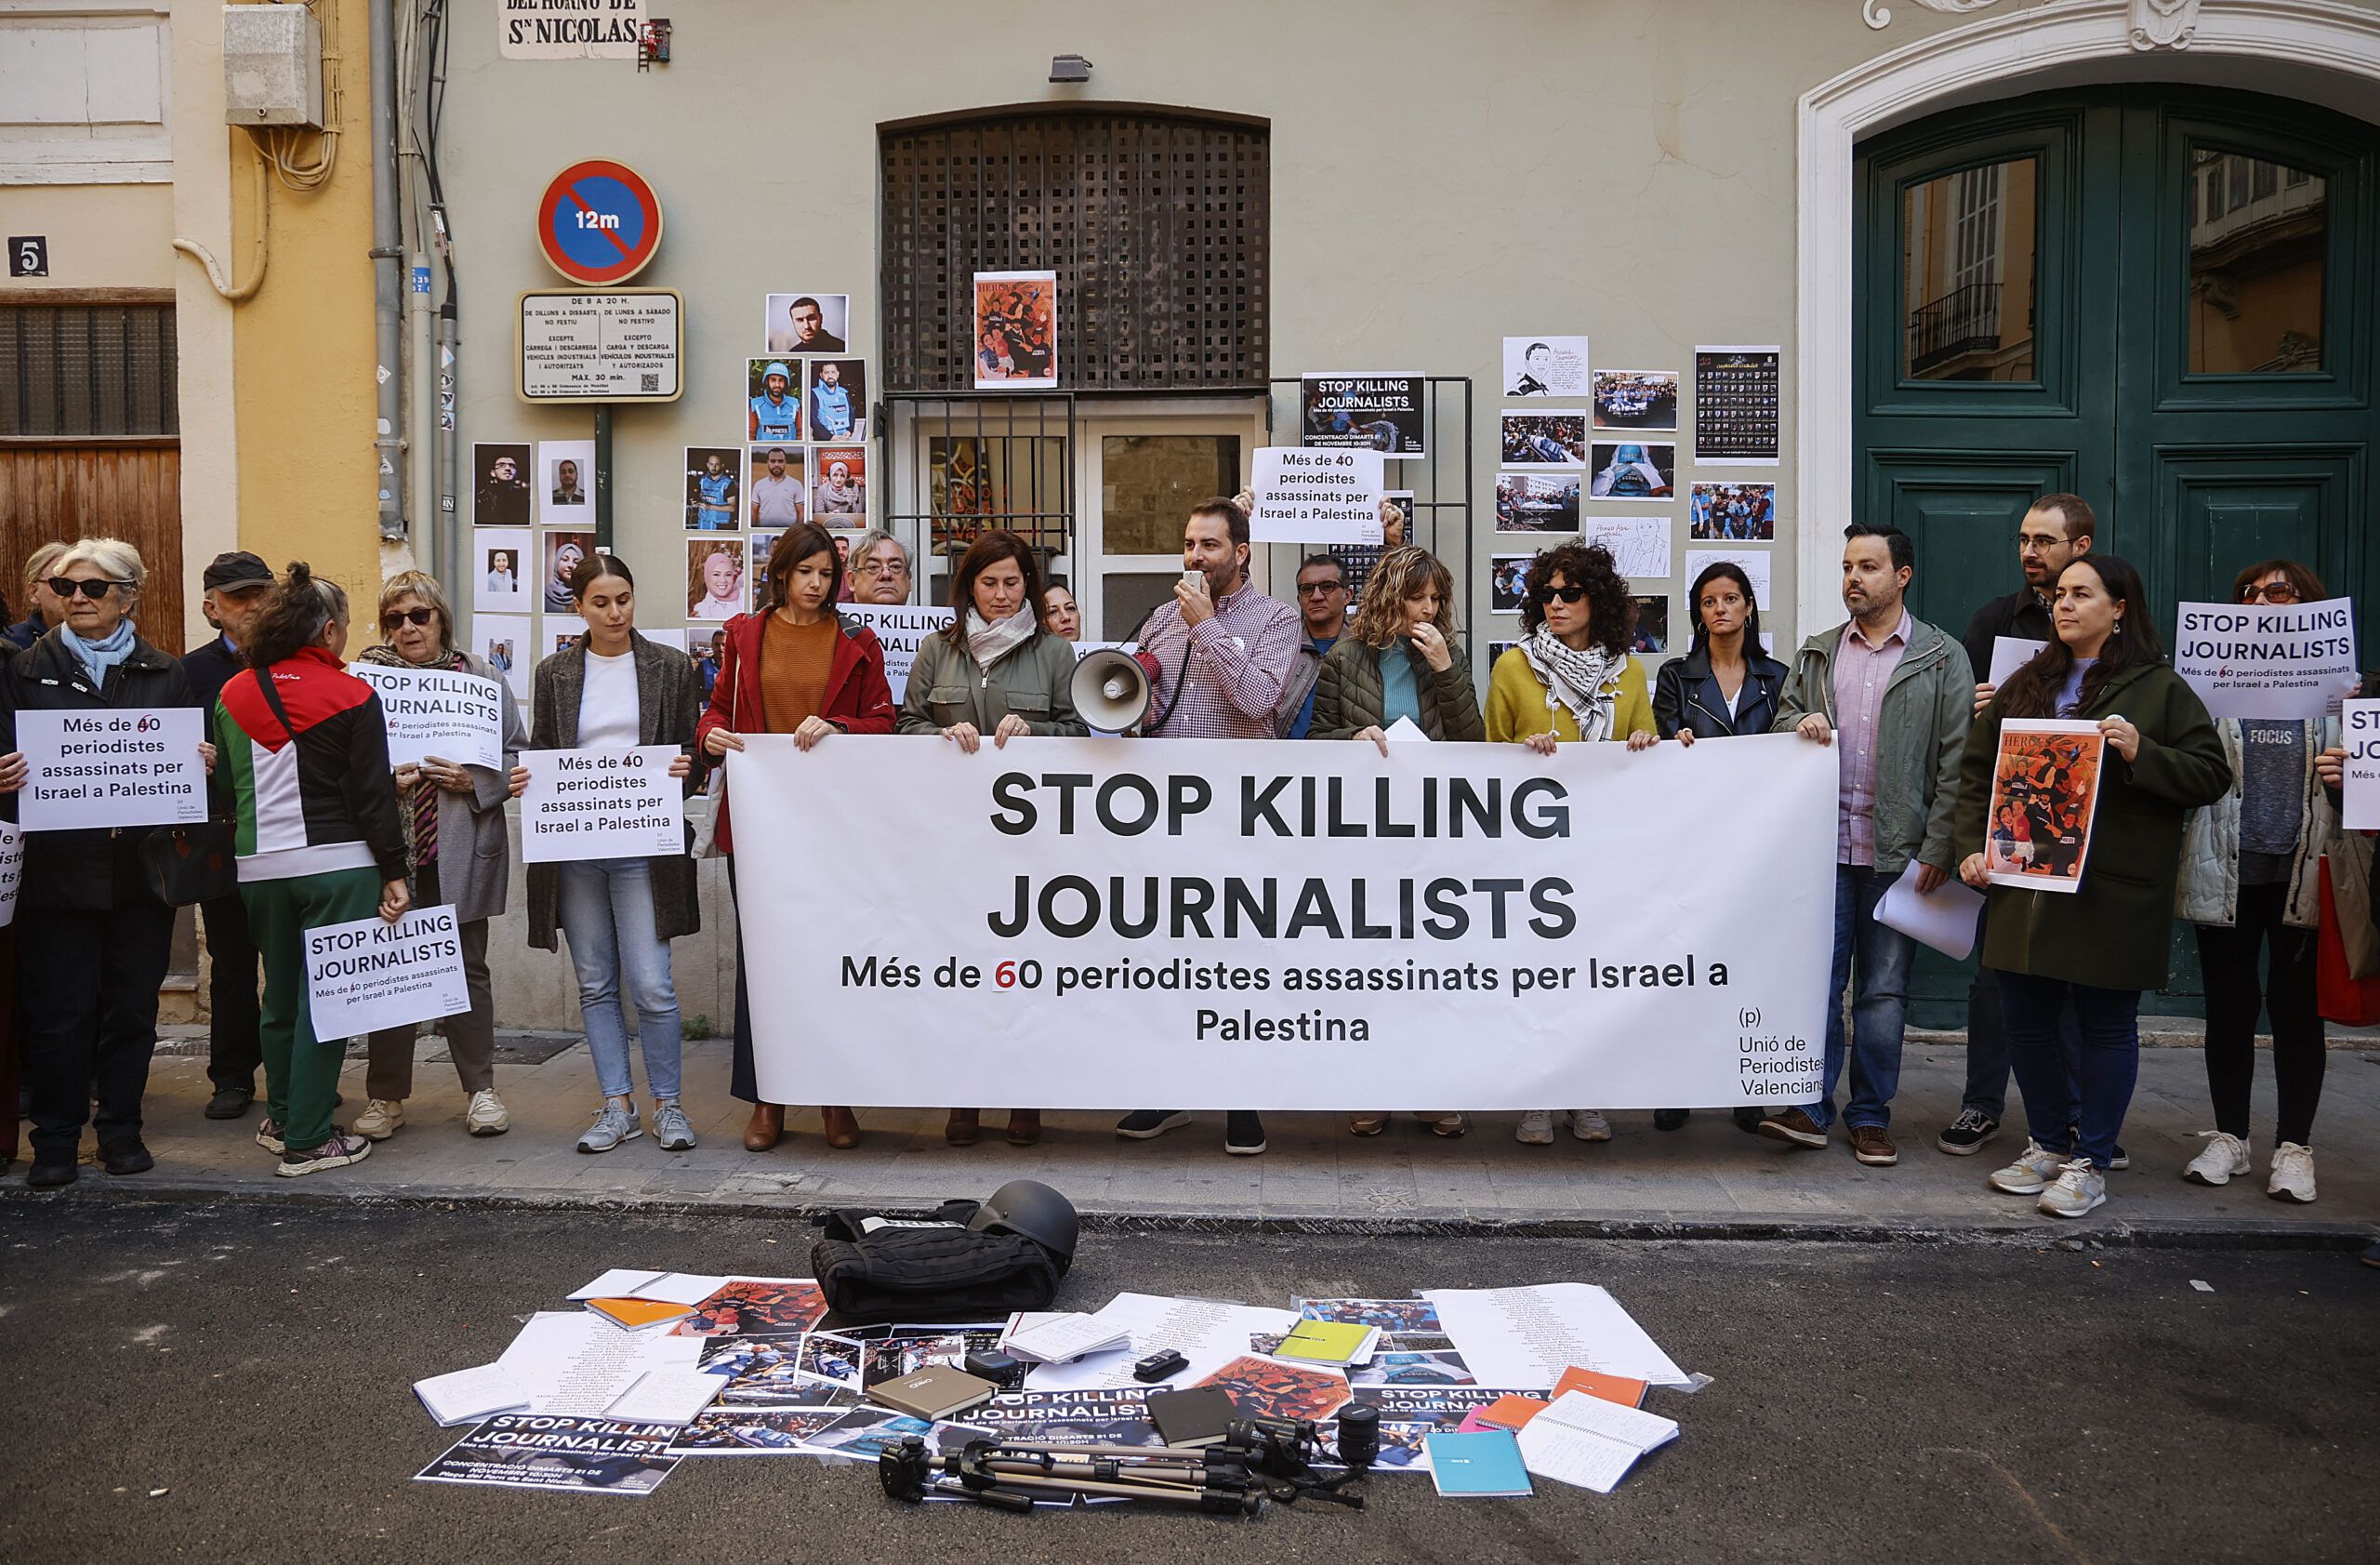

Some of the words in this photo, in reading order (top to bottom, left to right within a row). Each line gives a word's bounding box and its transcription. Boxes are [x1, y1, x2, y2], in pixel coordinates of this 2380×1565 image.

[575, 210, 620, 229] 12m
[20, 241, 39, 270] 5
[1318, 381, 1353, 391] STOP
[1357, 380, 1408, 391] KILLING
[1318, 396, 1408, 408] JOURNALISTS
[1283, 454, 1311, 466] Més
[1315, 455, 1331, 466] de
[1280, 471, 1355, 485] periodistes
[1266, 490, 1342, 502] assassinats
[1346, 493, 1368, 504] per
[1260, 507, 1296, 519] Israel
[1313, 509, 1373, 521] Palestina
[2184, 613, 2249, 633] STOP
[2257, 609, 2347, 633] KILLING
[2181, 637, 2349, 659] JOURNALISTS
[2181, 667, 2202, 676] Més
[2204, 668, 2217, 676] de
[2236, 669, 2294, 678] periodistes
[2296, 665, 2349, 677] assassinats
[418, 677, 497, 702] KILLING
[2213, 681, 2229, 689] per
[2273, 680, 2319, 688] Palestina
[63, 718, 102, 733] Més
[109, 718, 131, 731] de
[399, 731, 423, 739] Israel
[432, 730, 471, 738] Palestina
[402, 721, 450, 730] periodistes
[452, 722, 497, 736] assassinats
[2250, 729, 2292, 744] FOCUS
[60, 739, 165, 758] periodistes
[42, 762, 148, 777] assassinats
[153, 762, 183, 776] per
[558, 757, 592, 771] Més
[598, 756, 617, 769] de
[34, 784, 86, 800] Israel
[93, 788, 103, 798] a
[110, 781, 192, 797] Palestina
[557, 776, 647, 794] periodistes
[541, 797, 631, 813] assassinats
[637, 797, 663, 811] per
[989, 771, 1212, 837] STOP
[1239, 774, 1571, 840] KILLING
[535, 818, 578, 833] Israel
[584, 821, 592, 831] a
[599, 816, 670, 830] Palestina
[986, 874, 1577, 941] JOURNALISTS
[311, 930, 367, 955] STOP
[373, 915, 452, 944] KILLING
[314, 940, 456, 981] JOURNALISTS
[315, 986, 335, 998] Més
[337, 984, 348, 994] de
[363, 975, 409, 991] periodistes
[411, 964, 457, 979] assassinats
[840, 955, 921, 988] Més
[933, 956, 982, 988] de
[994, 959, 1043, 989] 60
[1055, 957, 1272, 997] periodistes
[1282, 959, 1500, 991] assassinats
[1513, 965, 1577, 998] per
[1589, 953, 1696, 989] Israel
[1708, 962, 1729, 987] a
[346, 995, 361, 1005] per
[363, 990, 385, 1001] Israel
[394, 981, 432, 994] Palestina
[1196, 1008, 1370, 1042] Palestina
[1739, 1007, 1761, 1028] (p)
[1739, 1035, 1779, 1053] Unió
[1784, 1035, 1806, 1051] de
[1739, 1055, 1824, 1074] Periodistes
[1740, 1077, 1823, 1095] Valencians
[1382, 1390, 1442, 1399] STOP
[963, 1404, 1148, 1421] JOURNALIST
[493, 1415, 575, 1430] STOP
[577, 1421, 679, 1438] KILLIN
[472, 1430, 670, 1453] JOURNALIST
[442, 1459, 527, 1470] CONCENTRACIÓ
[528, 1466, 576, 1475] DIMARTS
[469, 1467, 528, 1477] NOVEMBRE
[547, 1478, 584, 1486] Nicolau
